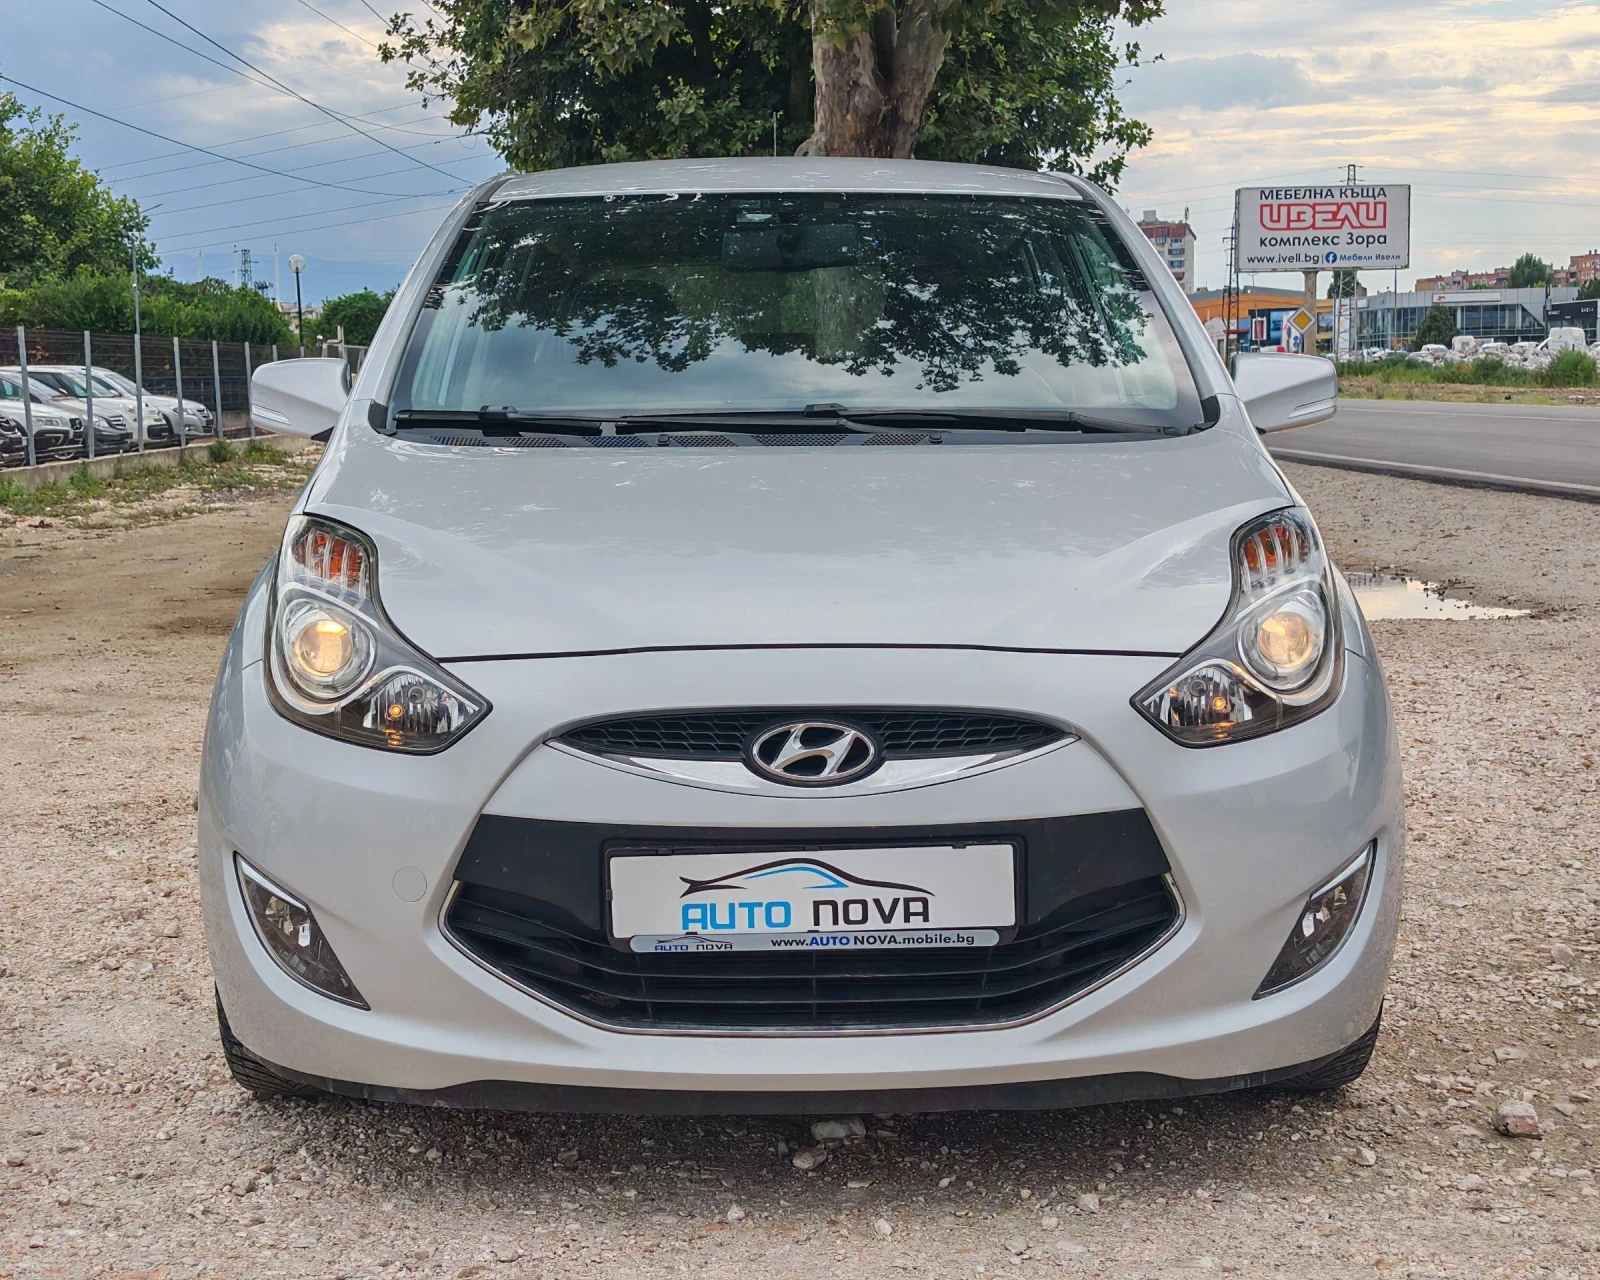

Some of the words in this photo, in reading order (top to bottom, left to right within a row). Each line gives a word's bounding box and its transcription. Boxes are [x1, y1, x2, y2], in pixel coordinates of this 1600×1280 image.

[1260, 188, 1335, 201] МЕБЕЛНА
[1339, 187, 1387, 200] КЪЩА
[1260, 201, 1387, 231] ИВЕЛИ
[1260, 233, 1340, 247] комплекс
[1346, 232, 1387, 248] Зора
[1247, 252, 1320, 264] www.iveli.bg
[1339, 253, 1373, 262] Мебели
[1375, 253, 1401, 261] Ивели
[681, 901, 791, 931] AUTO
[812, 897, 930, 926] NOVA
[655, 944, 689, 952] AUTO
